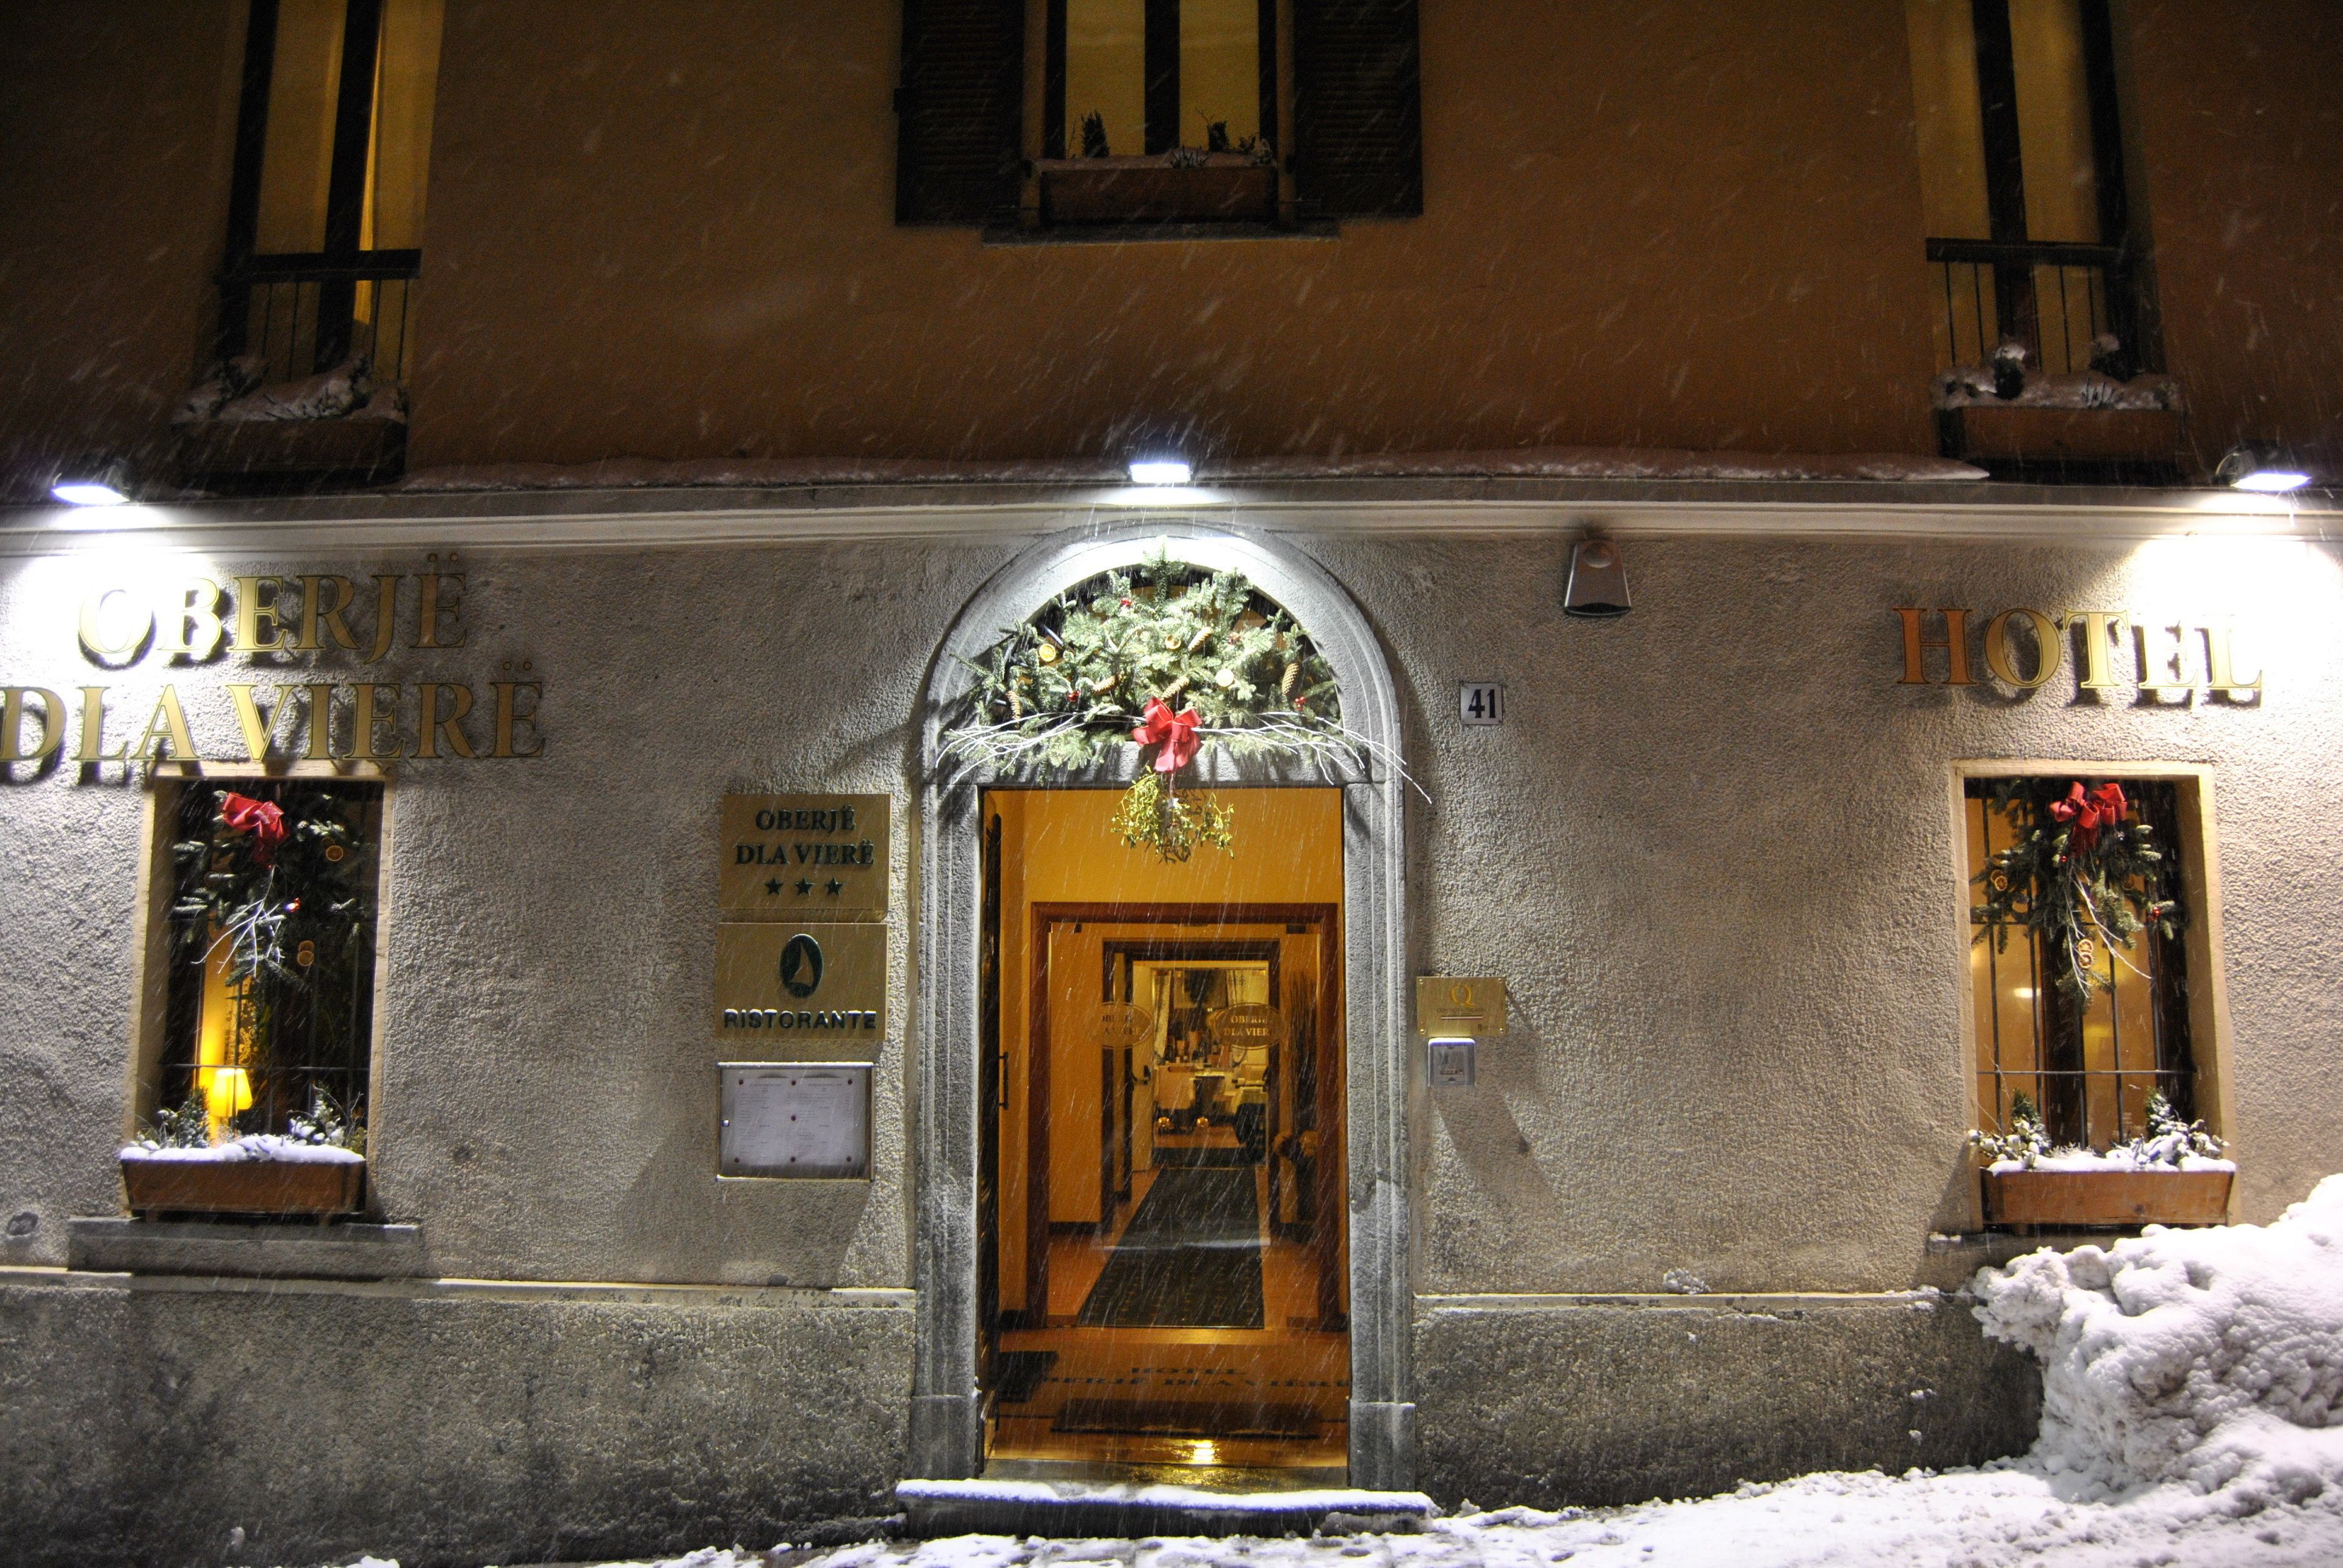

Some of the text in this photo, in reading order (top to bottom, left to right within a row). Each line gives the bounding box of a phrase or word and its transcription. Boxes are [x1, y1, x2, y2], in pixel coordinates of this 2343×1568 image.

[77, 553, 467, 664] OBERJË
[1892, 607, 2262, 690] HOTEL
[0, 661, 545, 762] DLA VIERË
[1467, 689, 1496, 718] 41
[755, 805, 856, 833] OBERJË
[735, 839, 876, 865] DLA VIERË
[724, 1009, 877, 1029] RISTORANTE
